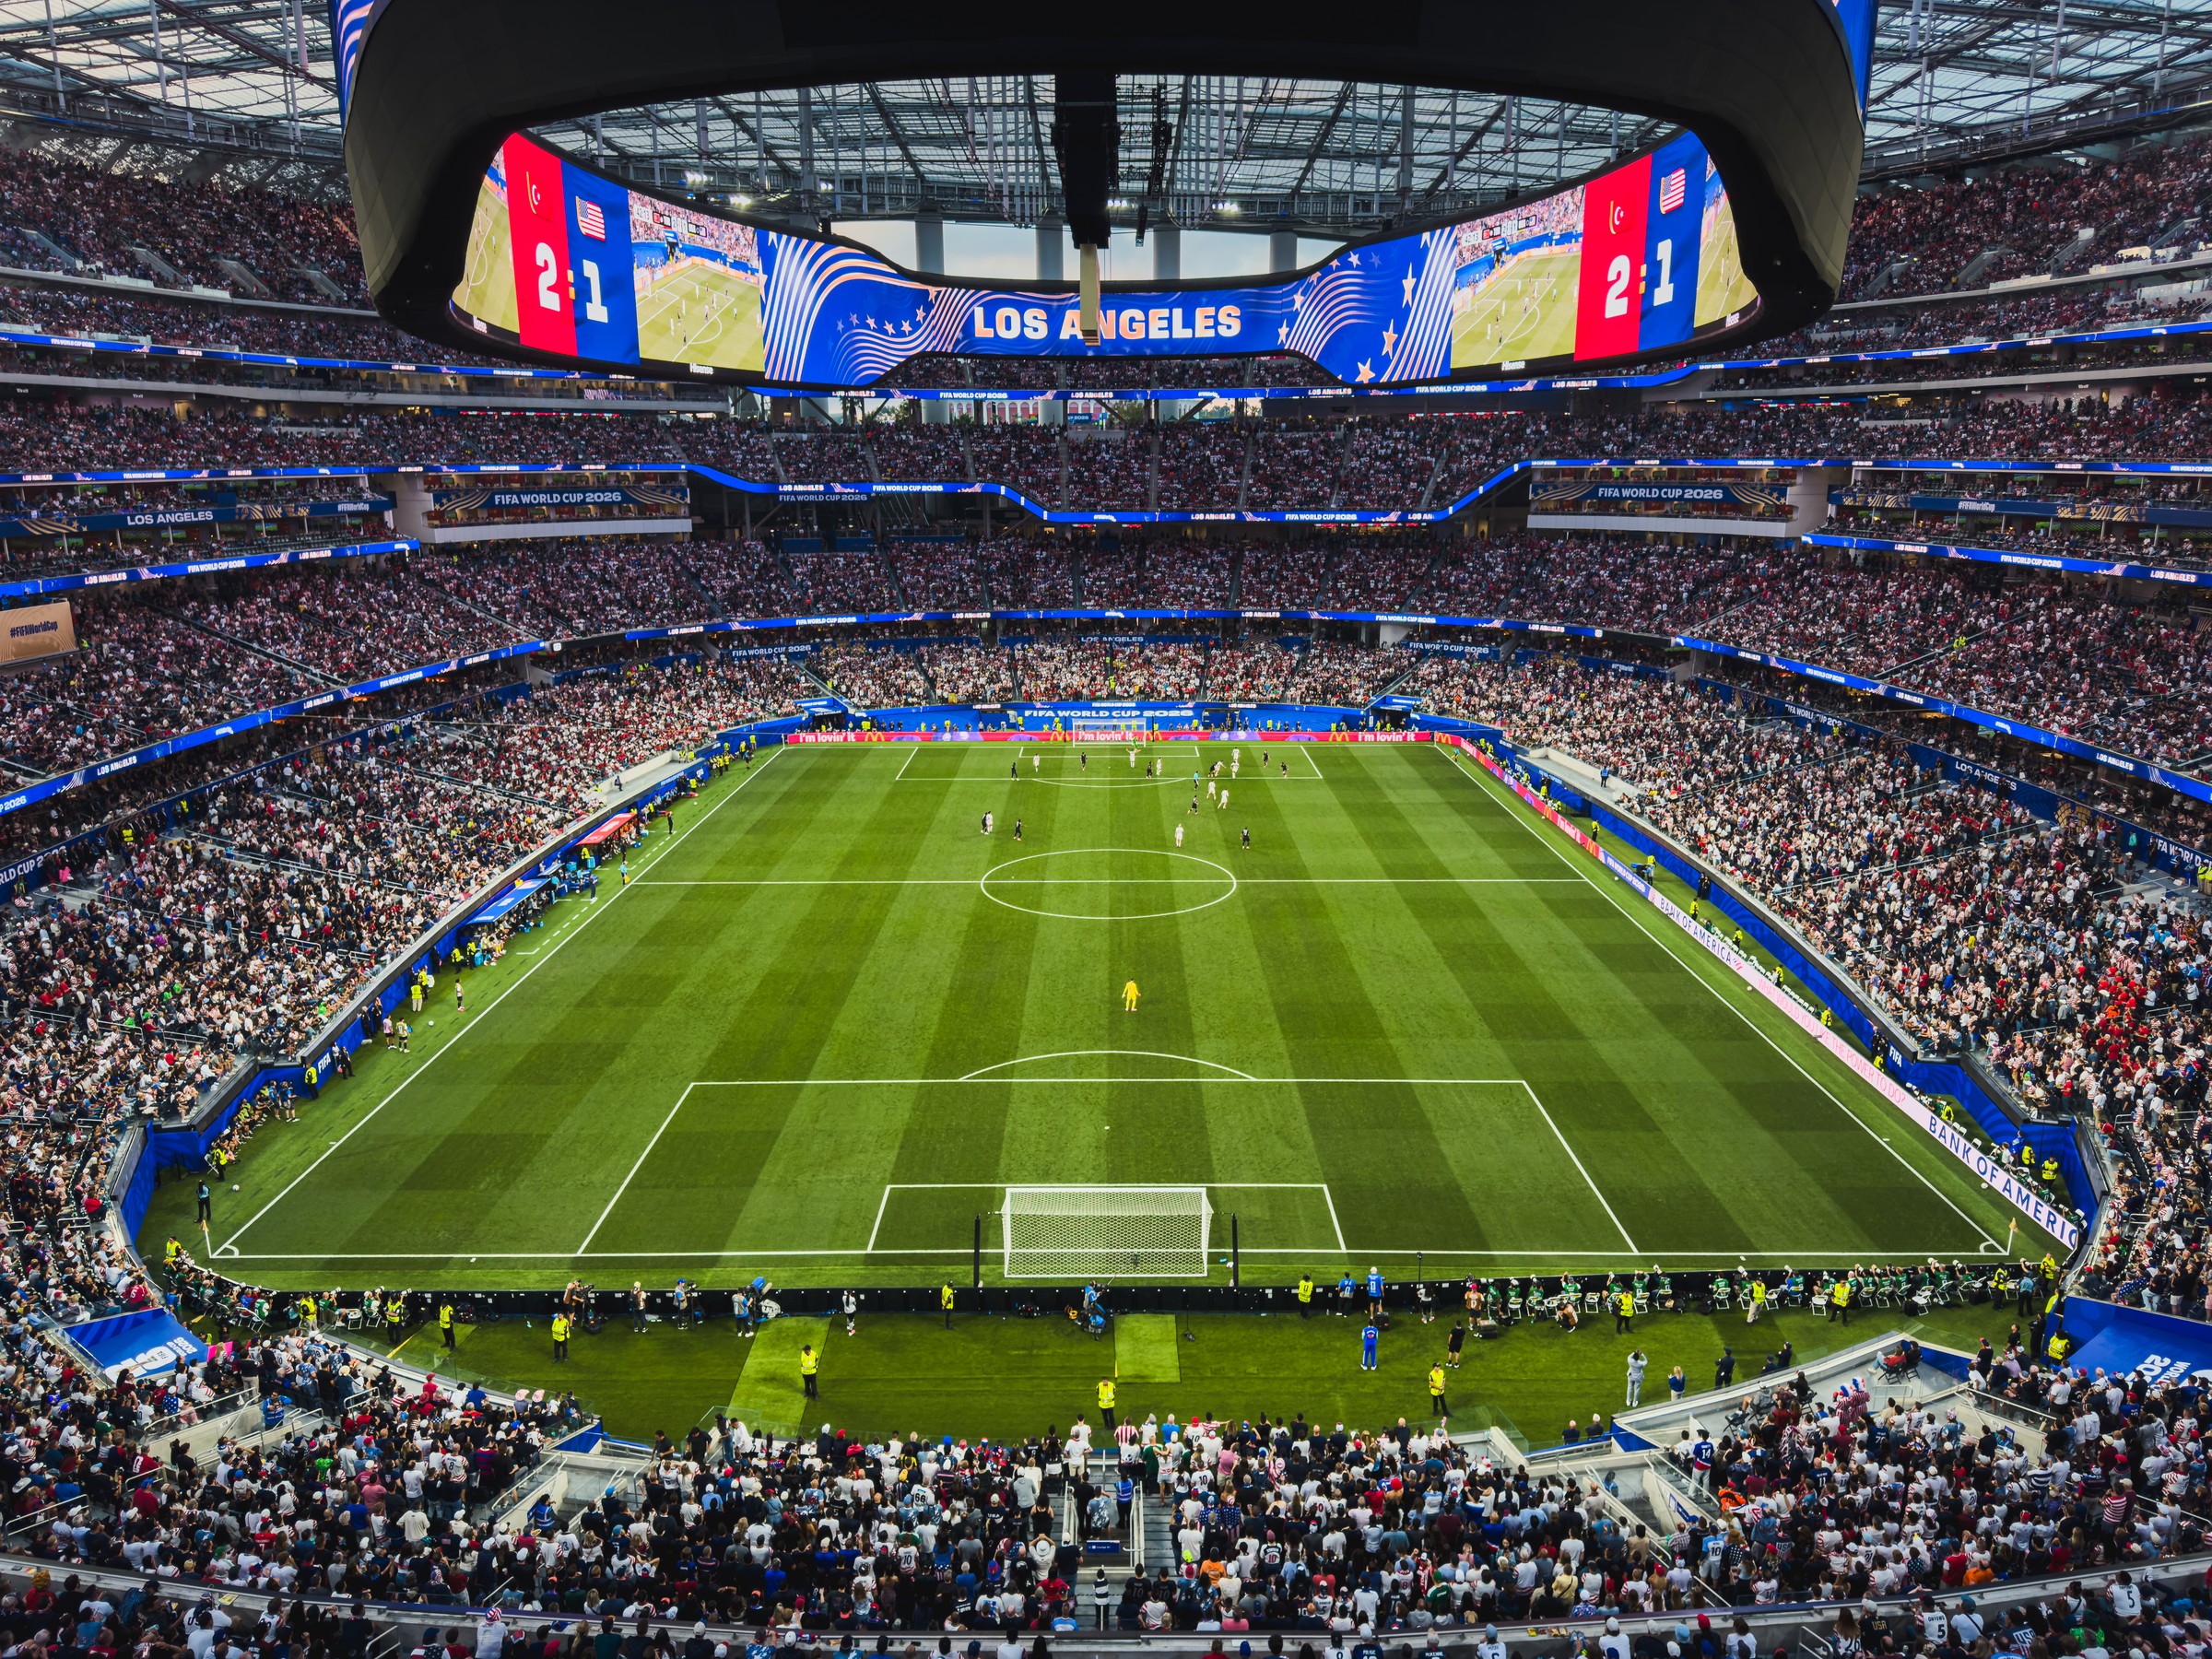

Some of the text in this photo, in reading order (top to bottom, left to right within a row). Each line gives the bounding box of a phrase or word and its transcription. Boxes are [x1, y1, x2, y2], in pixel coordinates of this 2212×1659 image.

[974, 305, 1241, 340] LOS ANGELES
[1502, 360, 1526, 371] Hisense
[495, 492, 621, 504] FIFA WORLD CUP 2026
[1599, 488, 1723, 499] FIFA WORLD CUP 2026
[127, 511, 213, 526] LOS ANGELES
[309, 550, 331, 559] ANGELES
[198, 563, 218, 571] WORLD
[85, 572, 127, 584] LOS ANGELES
[2150, 571, 2196, 582] LOS ANGELES
[10, 621, 58, 638] #FIFAWorldCup
[788, 645, 811, 653] 2026
[304, 700, 313, 709] LOS
[847, 733, 856, 742] it
[1126, 732, 1133, 741] it
[1407, 732, 1415, 741] it
[98, 754, 136, 775] LOS ANGELES
[2097, 753, 2135, 771] LOS ANGELES
[1955, 761, 1973, 775] LOS
[4, 795, 27, 811] 2026
[17, 859, 35, 875] CUP
[1661, 898, 1732, 964] BANK OF AMERICA
[1758, 977, 1906, 1106] WHAT WOULD YOU LIKE THE POWER TO DO?
[1889, 1046, 1902, 1067] FIFA
[318, 1053, 331, 1073] FIFA
[1929, 1115, 1970, 1164] BANK
[1977, 1156, 1999, 1183] OF
[1702, 1449, 1710, 1459] 14
[449, 1461, 454, 1470] 8
[1199, 1475, 1207, 1486] 10
[1819, 1477, 1826, 1487] 11
[915, 1493, 926, 1503] 66
[1711, 1547, 1721, 1556] 10
[903, 1555, 911, 1565] 10
[1269, 1554, 1277, 1563] 10
[2127, 1591, 2135, 1608] 5
[1871, 1620, 1887, 1630] USA
[1938, 1624, 1945, 1639] 5
